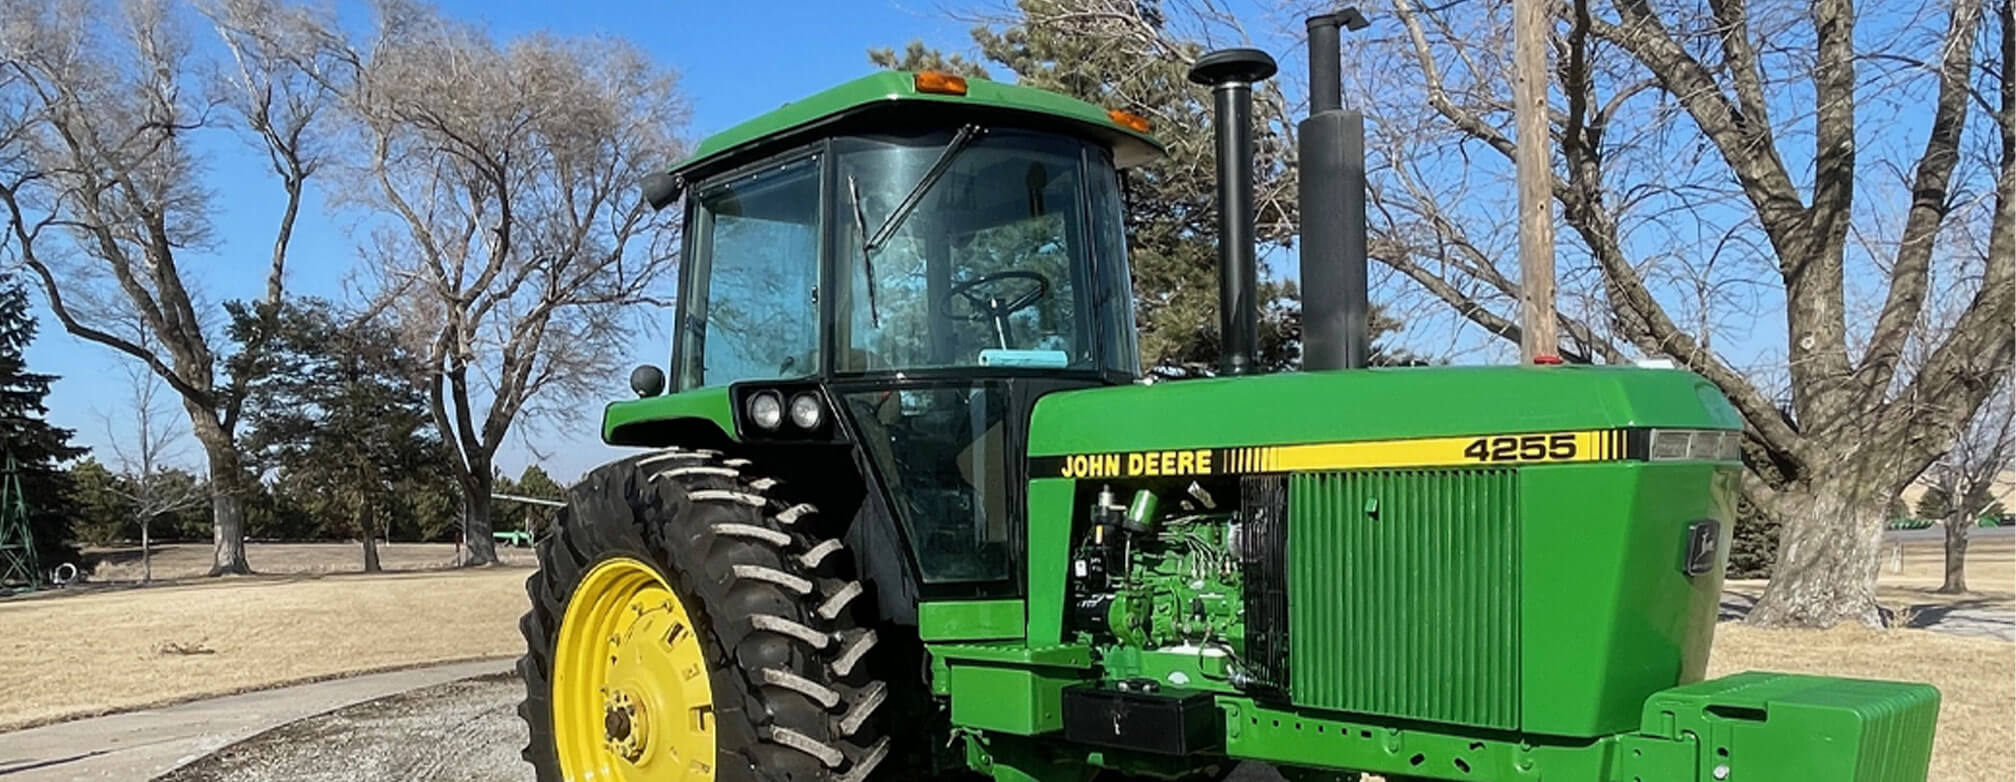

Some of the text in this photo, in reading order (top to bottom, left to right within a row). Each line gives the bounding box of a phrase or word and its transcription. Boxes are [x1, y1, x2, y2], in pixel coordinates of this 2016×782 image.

[1464, 434, 1577, 462] 4255
[1061, 449, 1212, 477] JOHN DEERE
